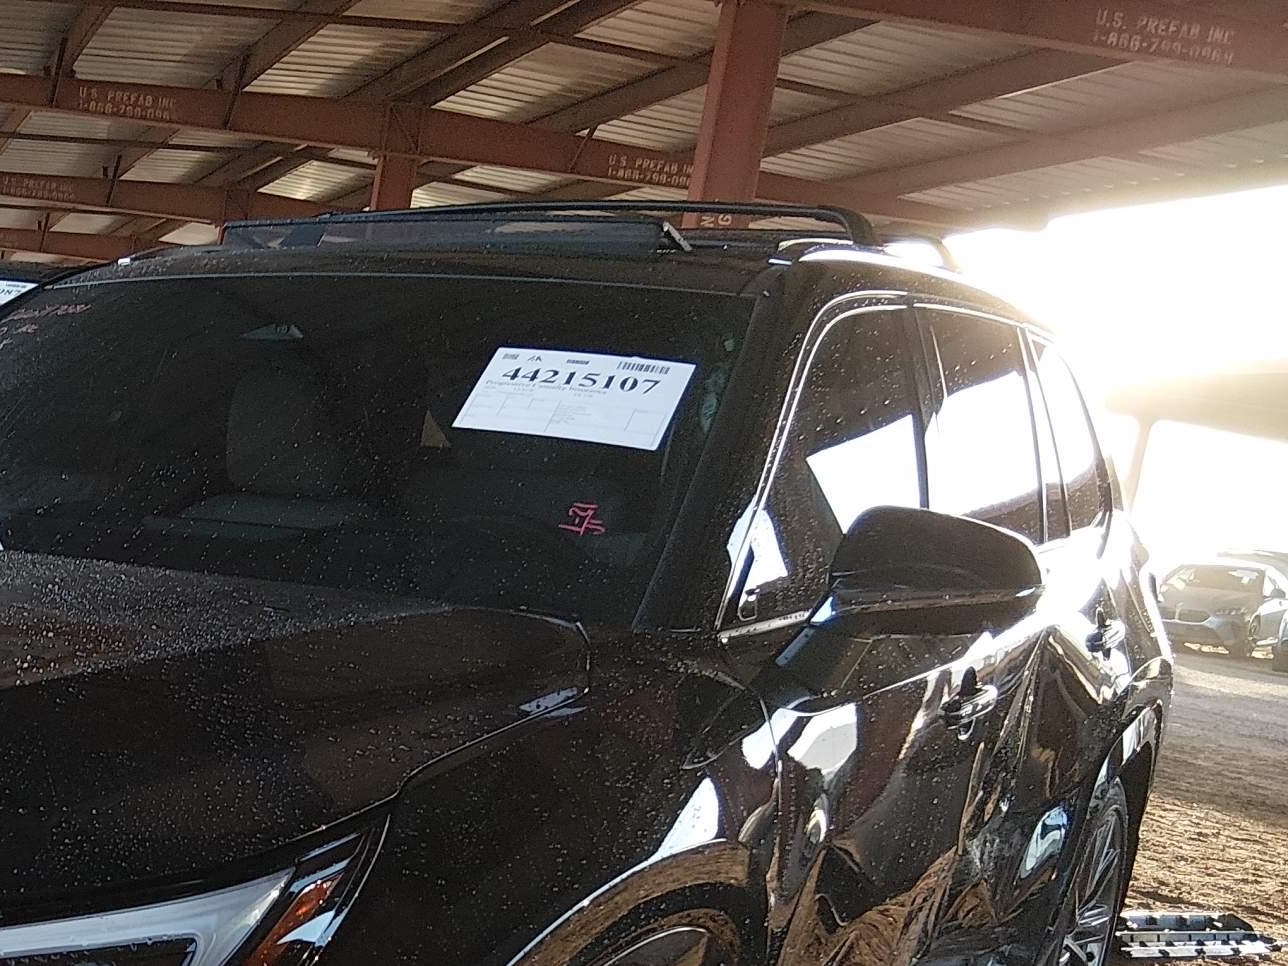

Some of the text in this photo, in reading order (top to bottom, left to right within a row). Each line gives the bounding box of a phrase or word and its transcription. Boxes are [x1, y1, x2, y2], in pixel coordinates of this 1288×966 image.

[1096, 7, 1127, 30] U.S.
[1136, 16, 1201, 39] PREFAB
[107, 90, 153, 107] PREFAB
[635, 158, 679, 174] PREFAB
[502, 367, 662, 395] 44215107
